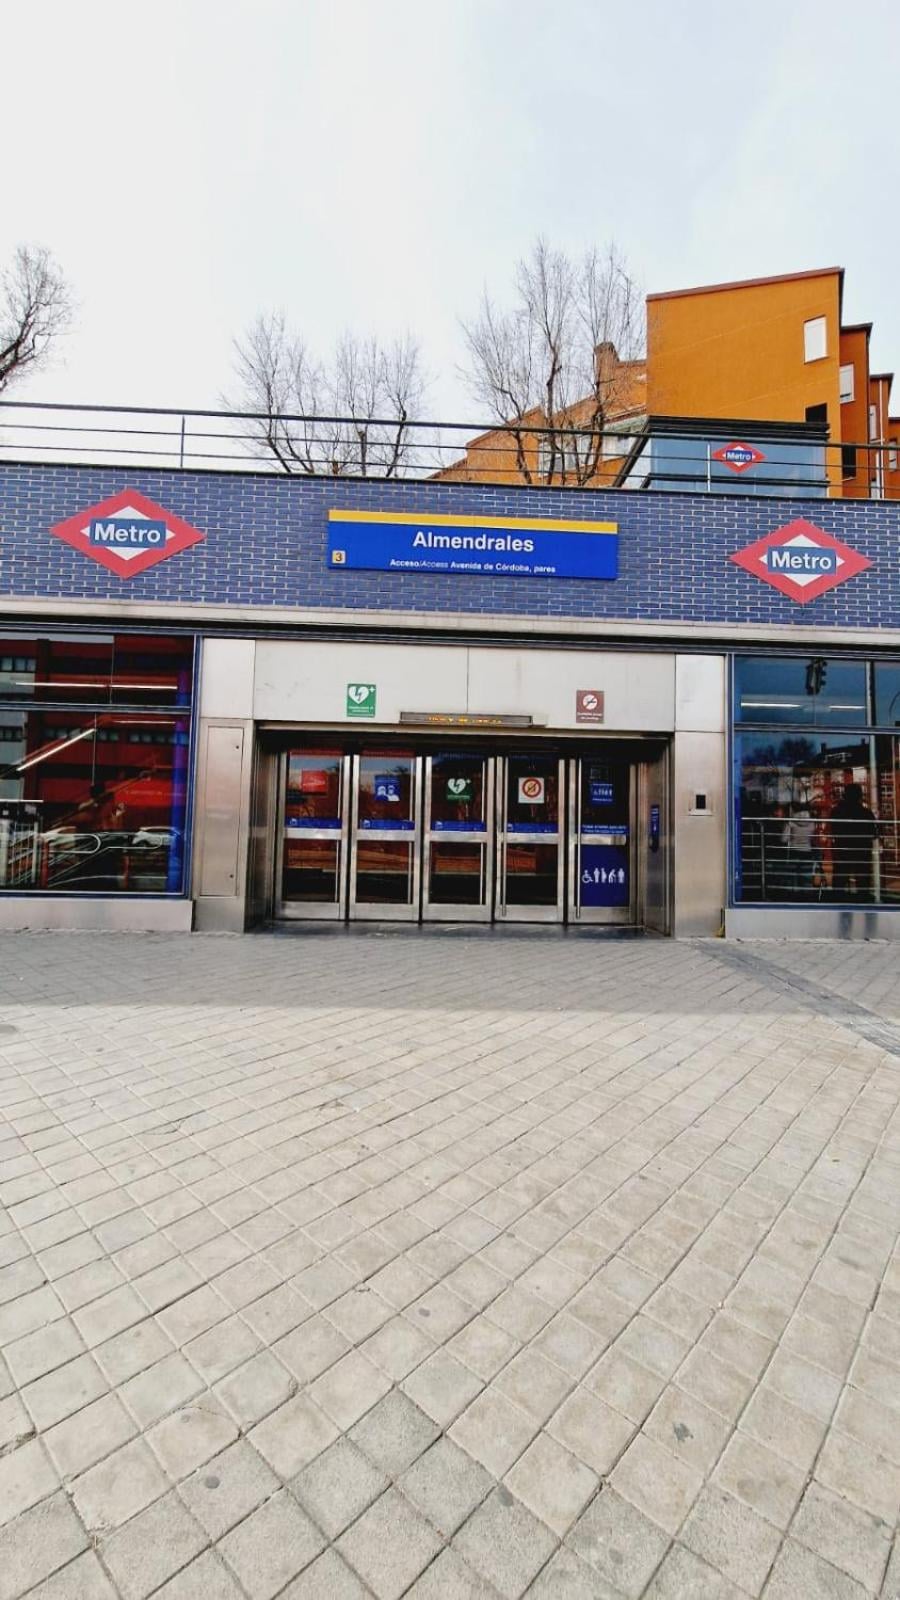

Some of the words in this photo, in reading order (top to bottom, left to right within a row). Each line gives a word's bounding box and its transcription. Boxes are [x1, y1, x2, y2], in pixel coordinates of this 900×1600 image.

[726, 452, 751, 460] Metro
[94, 522, 161, 543] Metro
[412, 531, 534, 552] Almendrales
[335, 552, 343, 562] 3
[771, 551, 832, 570] Metro
[450, 561, 482, 570] Avenida
[495, 562, 532, 573] Córdoba,
[533, 565, 556, 573] pares
